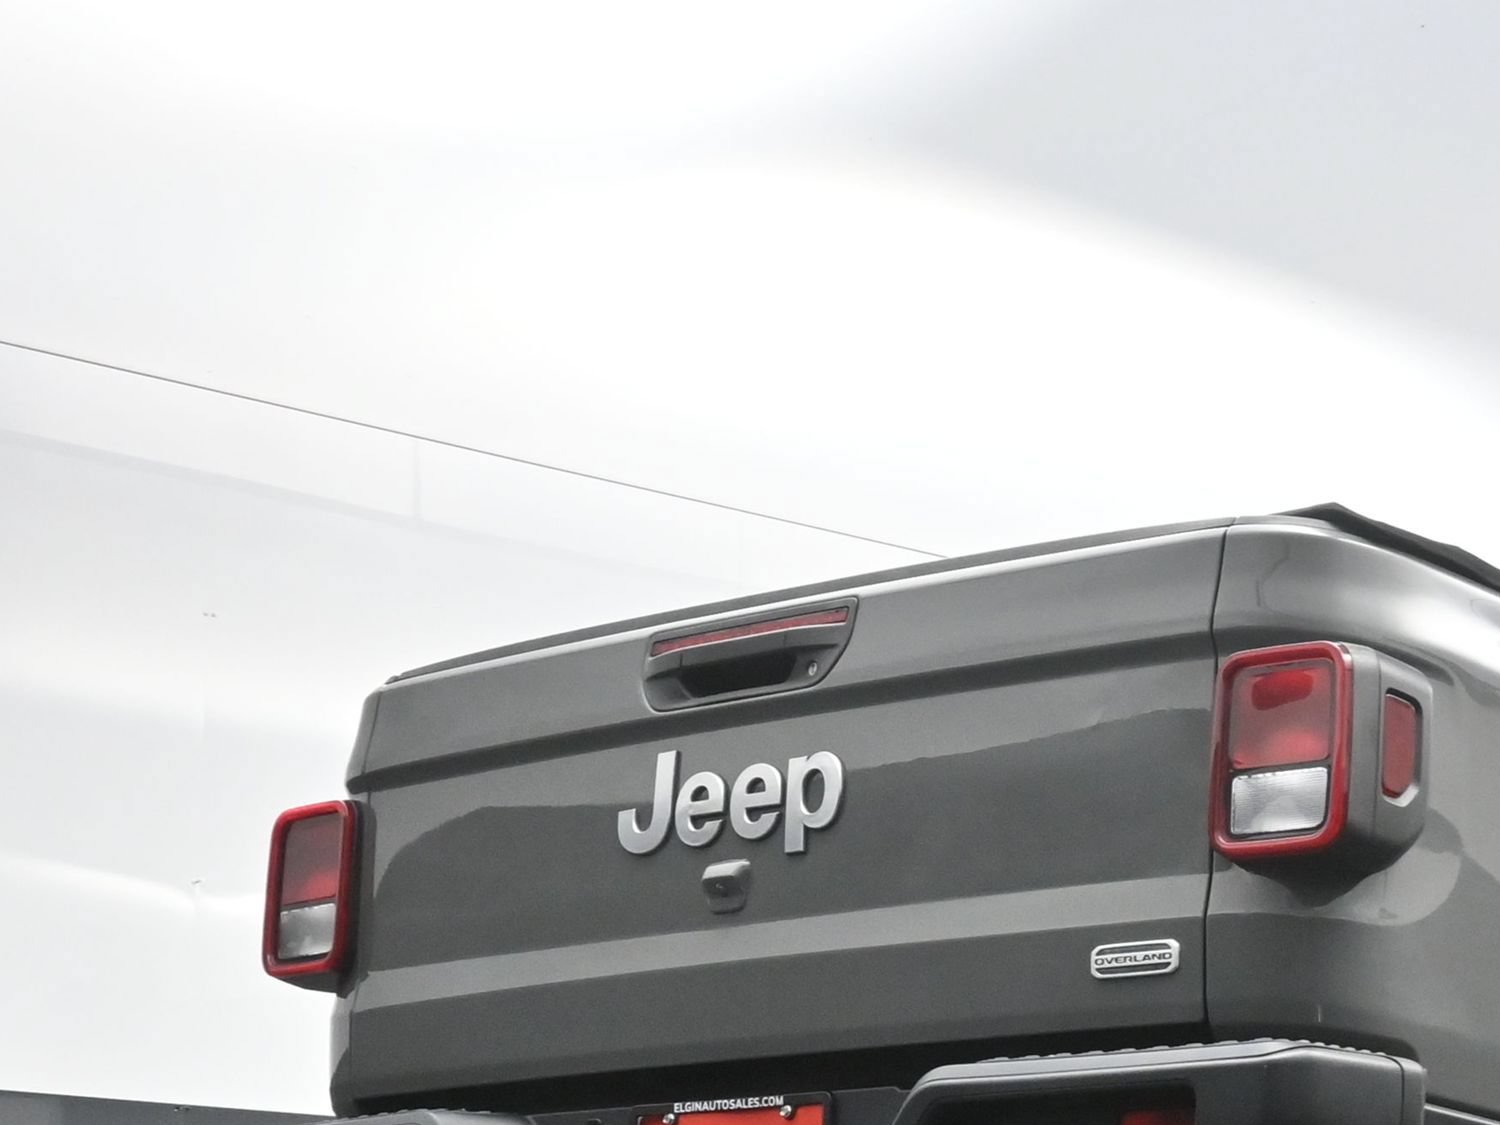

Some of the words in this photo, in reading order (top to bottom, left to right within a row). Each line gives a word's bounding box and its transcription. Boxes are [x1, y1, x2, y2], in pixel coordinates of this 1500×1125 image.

[617, 750, 844, 854] Jeep
[1094, 952, 1173, 966] OVERLAND
[673, 1095, 785, 1114] ELGINAUTOSALES.COM
